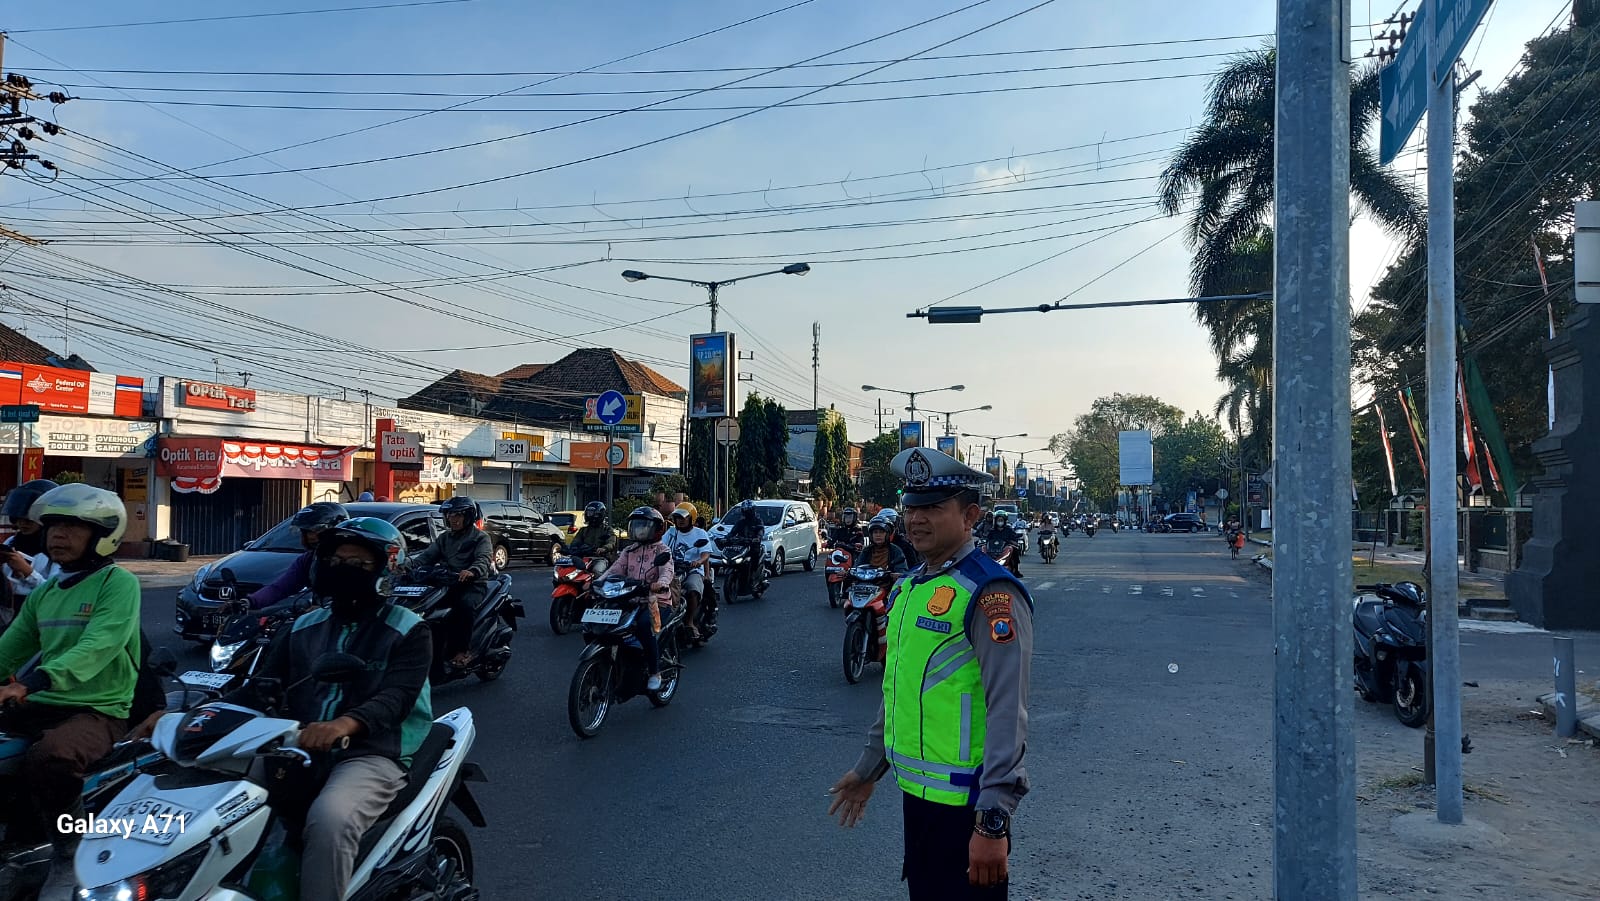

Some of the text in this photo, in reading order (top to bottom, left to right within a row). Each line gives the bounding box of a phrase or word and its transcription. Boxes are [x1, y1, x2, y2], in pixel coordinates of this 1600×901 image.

[228, 396, 257, 409] Tata
[40, 417, 86, 432] STOP
[385, 434, 405, 445] Tata
[161, 447, 217, 464] Optik Tata
[918, 617, 949, 632] POLRI
